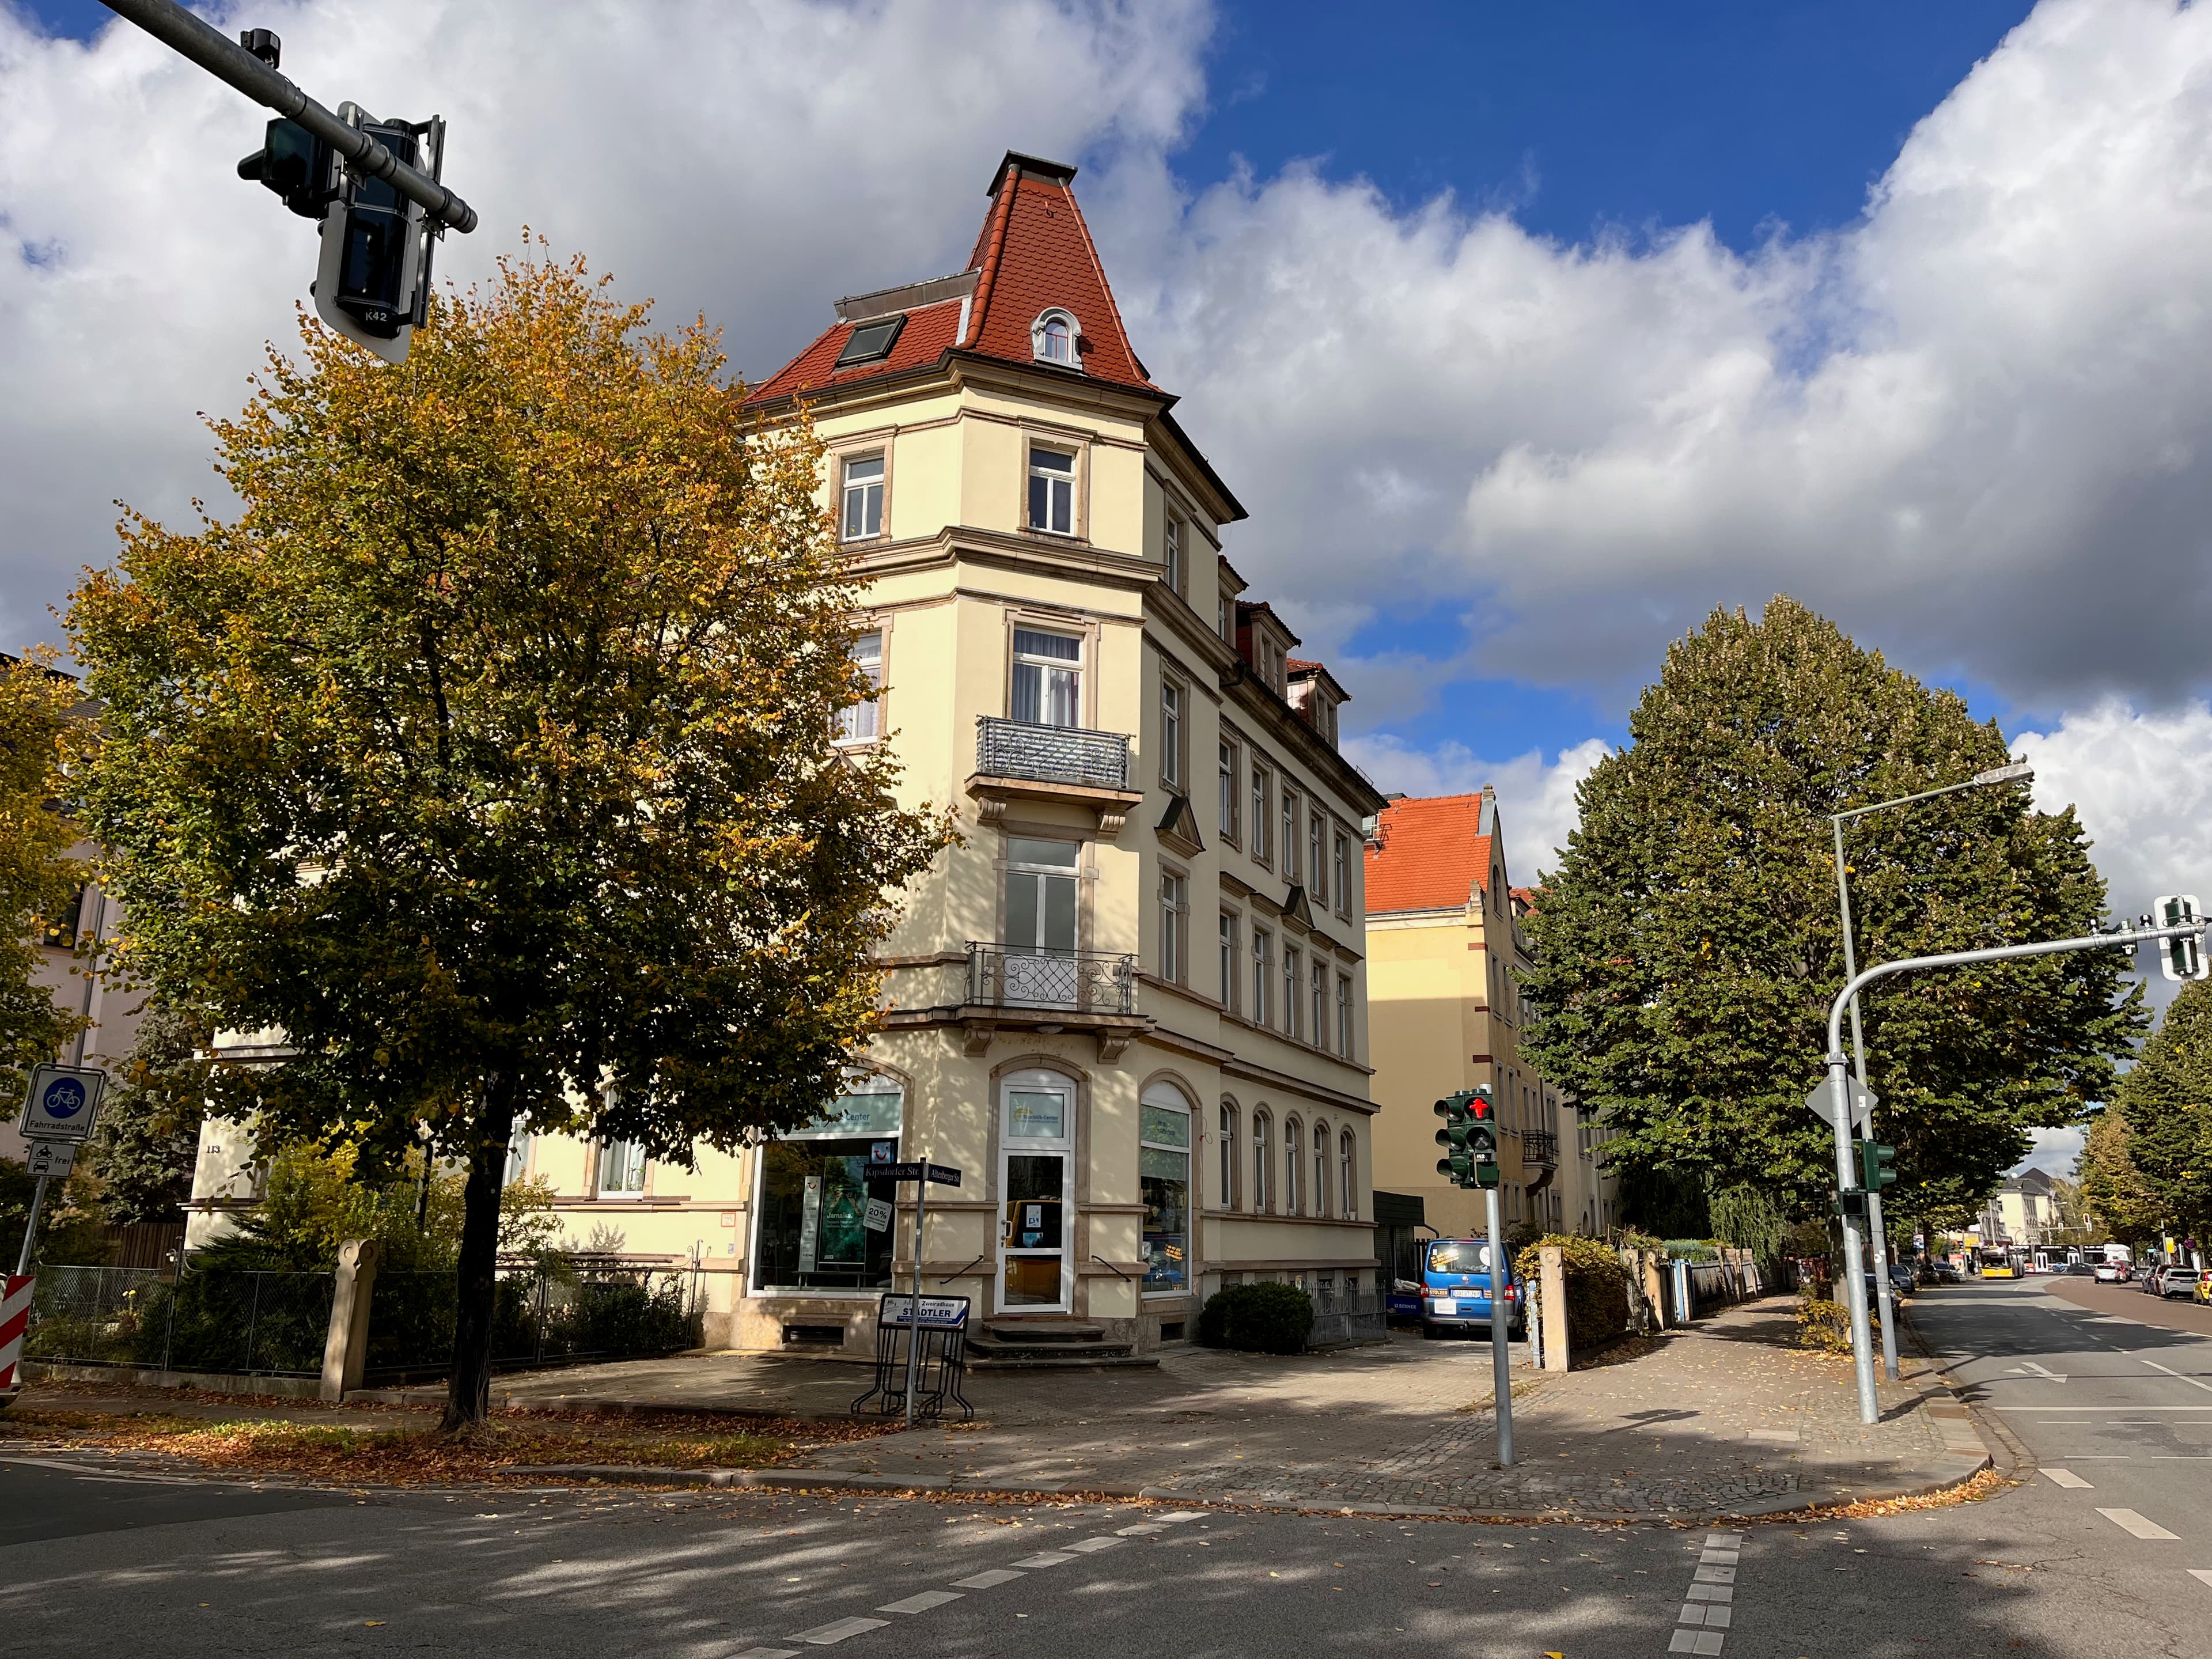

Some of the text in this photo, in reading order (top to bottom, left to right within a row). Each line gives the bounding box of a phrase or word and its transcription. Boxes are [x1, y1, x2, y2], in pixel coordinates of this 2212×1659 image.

[365, 312, 387, 321] K42
[29, 1120, 85, 1131] Fahrradstraße
[54, 1156, 71, 1164] frei
[866, 1166, 920, 1179] Kipsdorfer Str.
[931, 1169, 954, 1183] Altenberger
